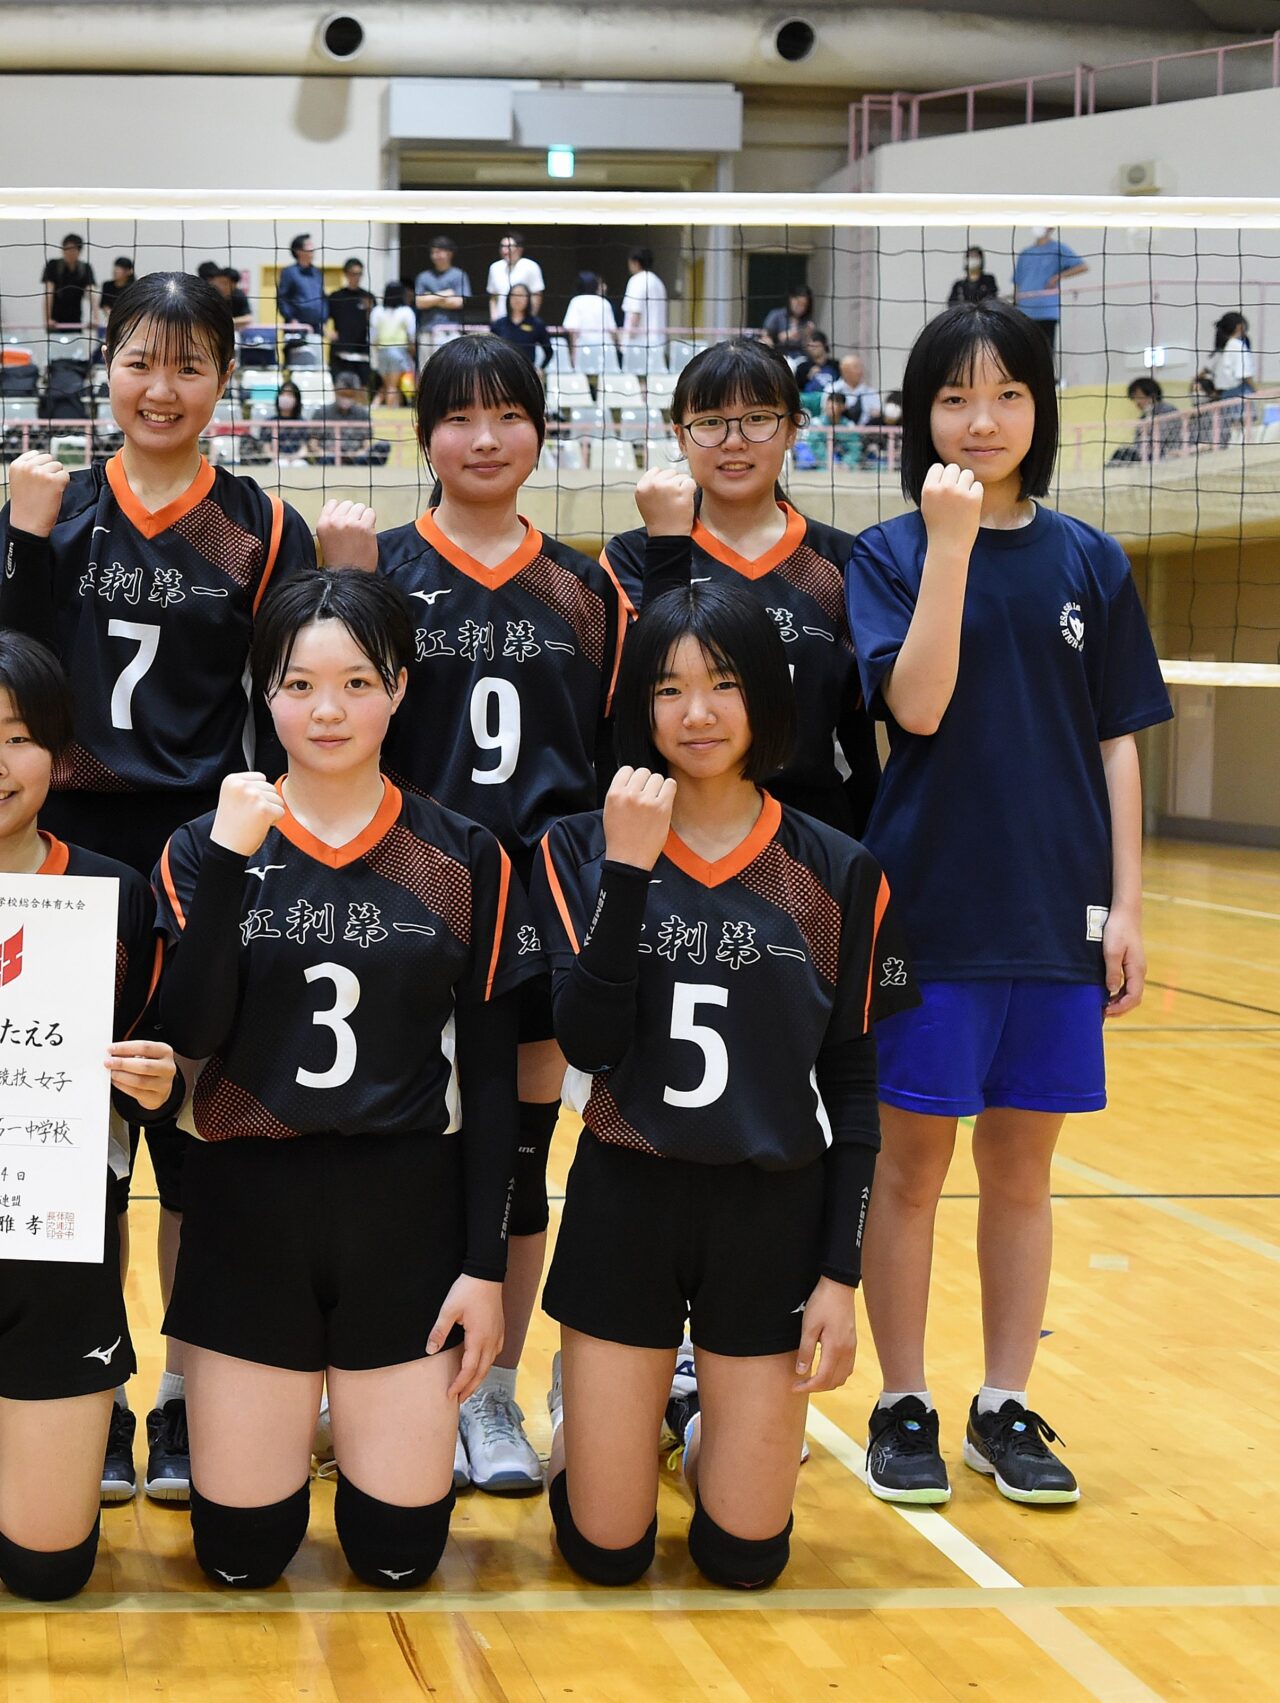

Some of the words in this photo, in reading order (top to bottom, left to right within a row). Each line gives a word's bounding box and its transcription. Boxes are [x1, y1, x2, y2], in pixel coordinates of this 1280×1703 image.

[107, 618, 161, 730] 7
[414, 619, 577, 663] 江刺第一
[470, 676, 521, 785] 9
[239, 899, 436, 949] 江刺第一
[517, 925, 541, 955] 岩
[880, 957, 908, 987] 岩
[295, 961, 361, 1089] 3
[663, 981, 729, 1108] 5
